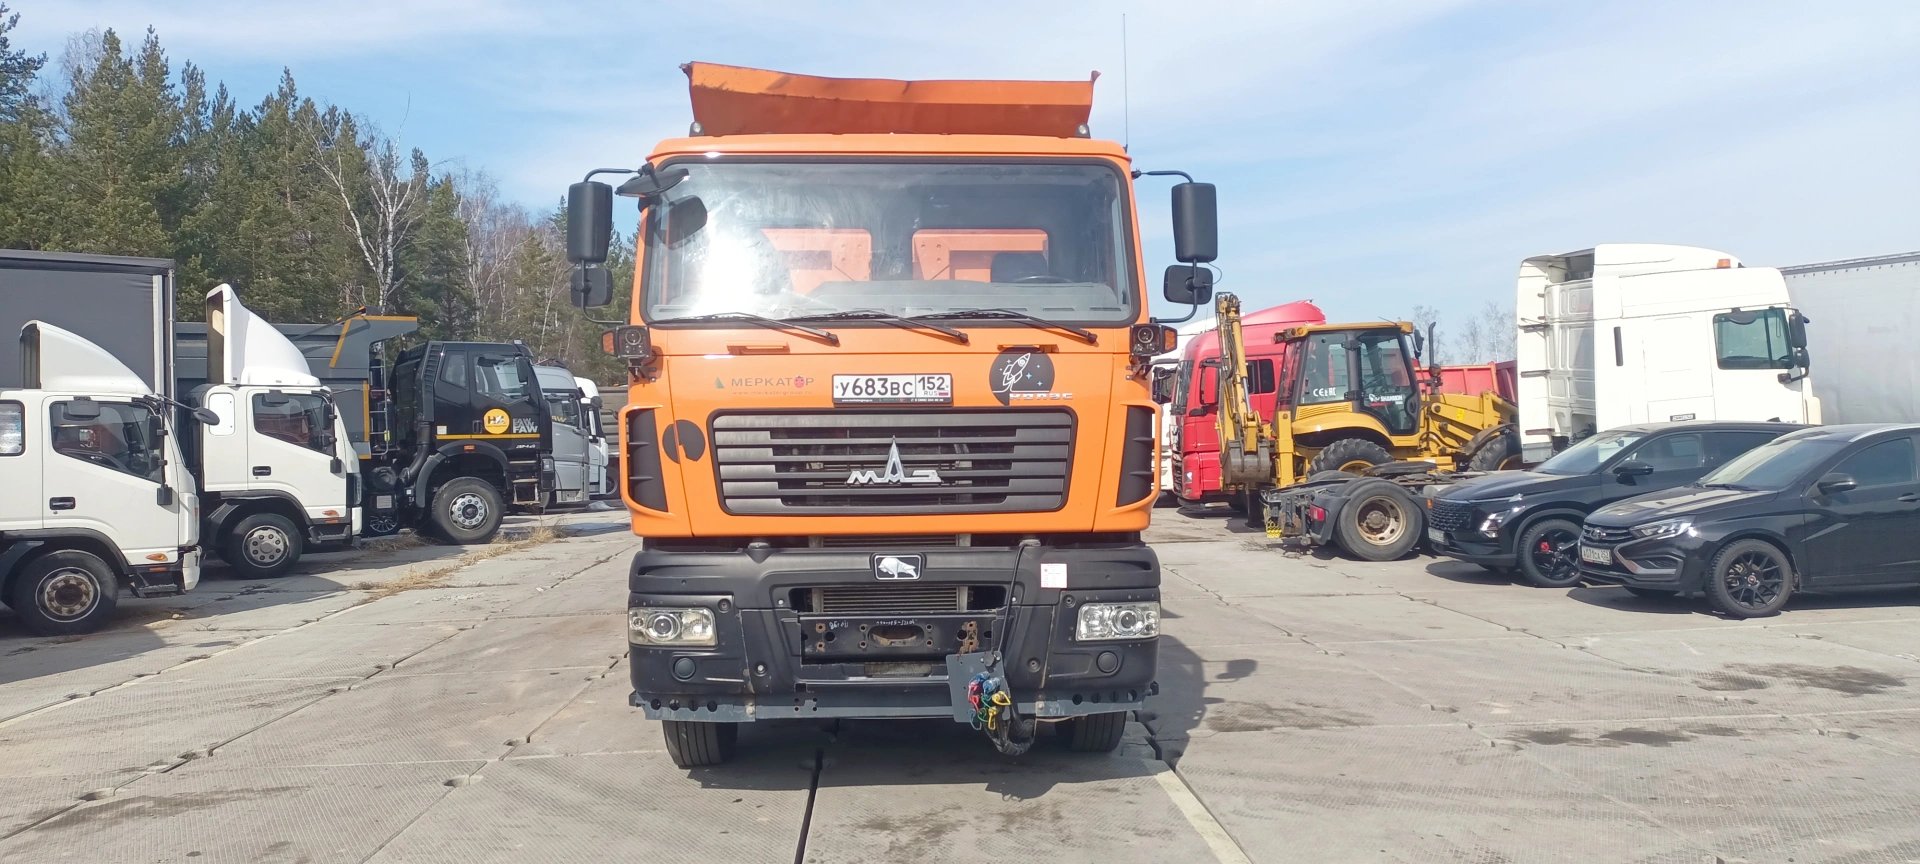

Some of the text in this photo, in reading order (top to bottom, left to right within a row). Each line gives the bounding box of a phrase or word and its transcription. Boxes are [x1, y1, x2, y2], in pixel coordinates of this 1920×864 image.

[840, 376, 945, 396] У683ВС 152
[513, 425, 538, 433] FAW
